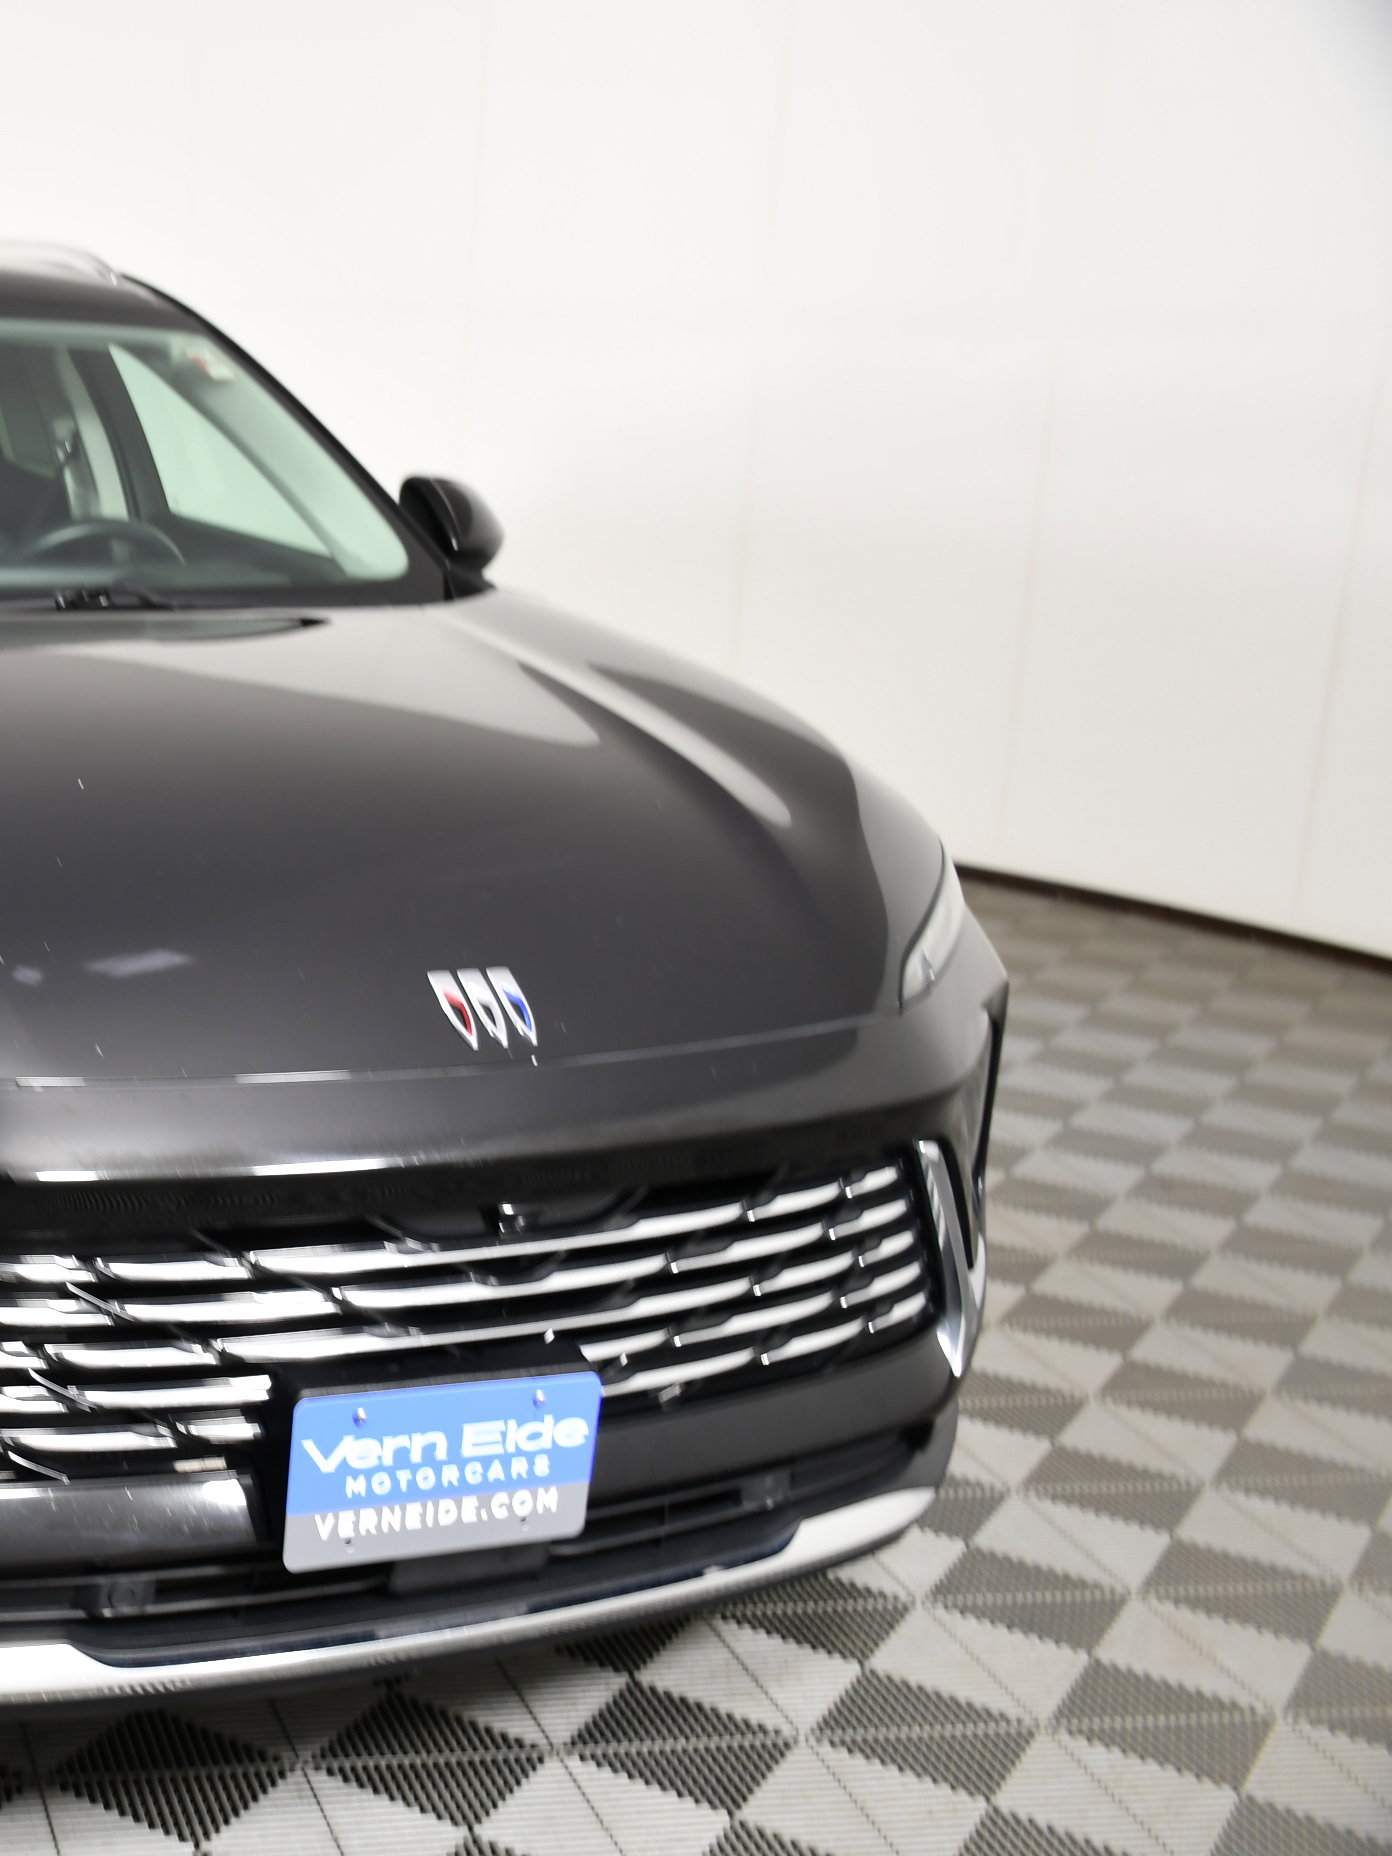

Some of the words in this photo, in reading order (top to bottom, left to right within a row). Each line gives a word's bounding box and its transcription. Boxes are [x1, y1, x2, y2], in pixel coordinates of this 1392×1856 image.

[301, 1430, 448, 1473] Vern
[345, 1453, 551, 1499] MOTORCARS
[314, 1486, 558, 1541] VERNEIDE.COM
